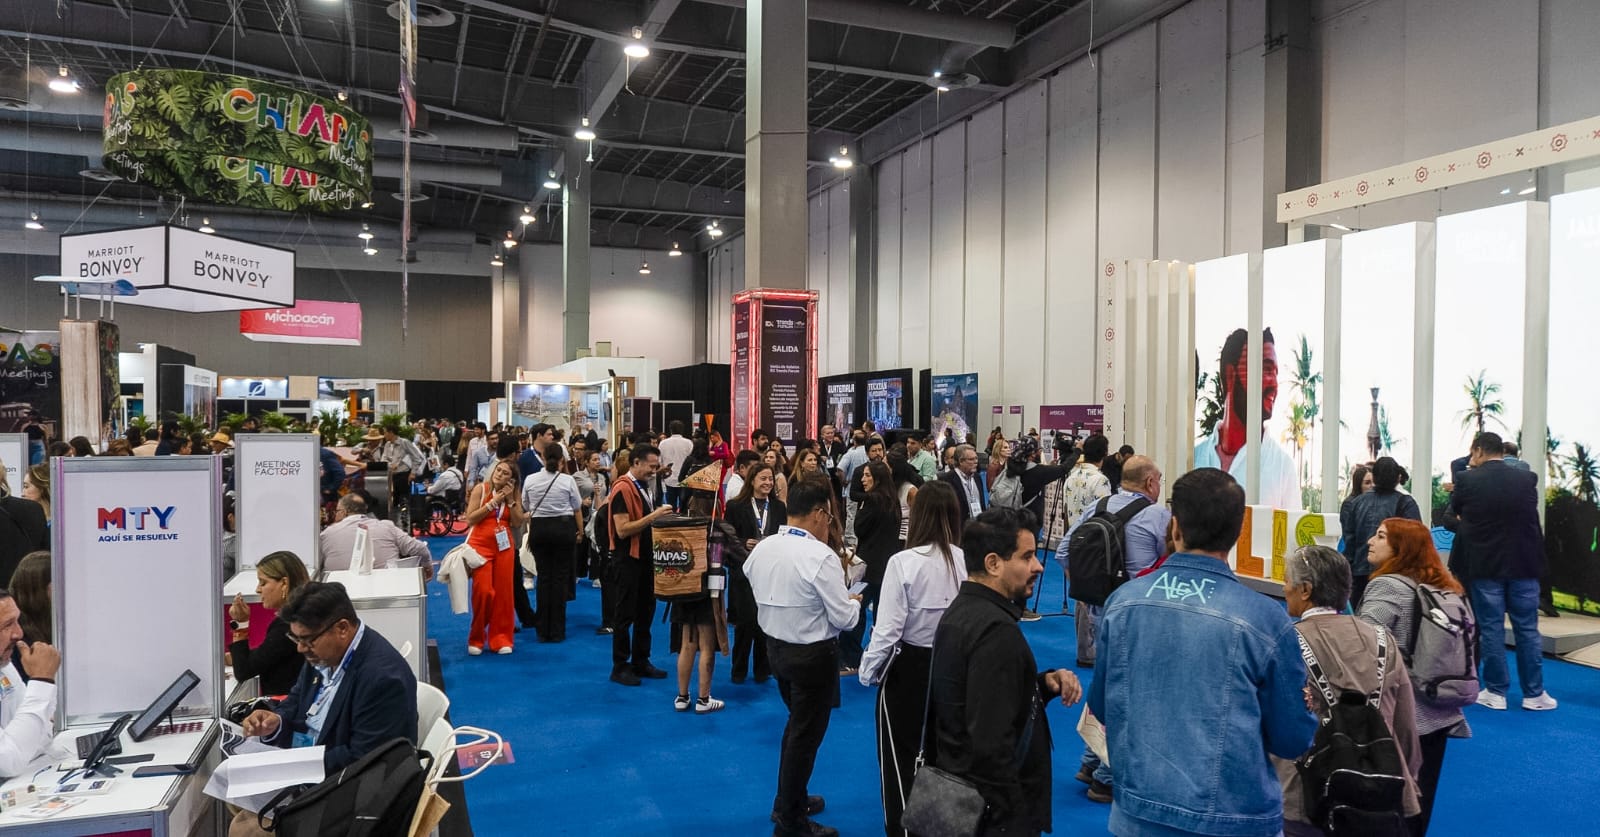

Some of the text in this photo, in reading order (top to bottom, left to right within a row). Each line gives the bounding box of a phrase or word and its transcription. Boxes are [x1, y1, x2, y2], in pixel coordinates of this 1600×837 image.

[223, 88, 368, 161] CHIAPAS
[111, 151, 145, 183] eetings
[309, 184, 355, 210] Meetings
[88, 245, 134, 259] MARRIOTT
[205, 250, 261, 269] MARRIOTT
[80, 257, 143, 278] BONVOY
[194, 260, 269, 289] BONVOY
[264, 309, 335, 326] Michoacán
[771, 345, 799, 353] SALIDA
[255, 460, 301, 468] MEETINGS
[255, 467, 301, 476] FACTORY
[97, 506, 177, 531] MTY
[98, 533, 179, 543] AQUÍ SE RESUELVE
